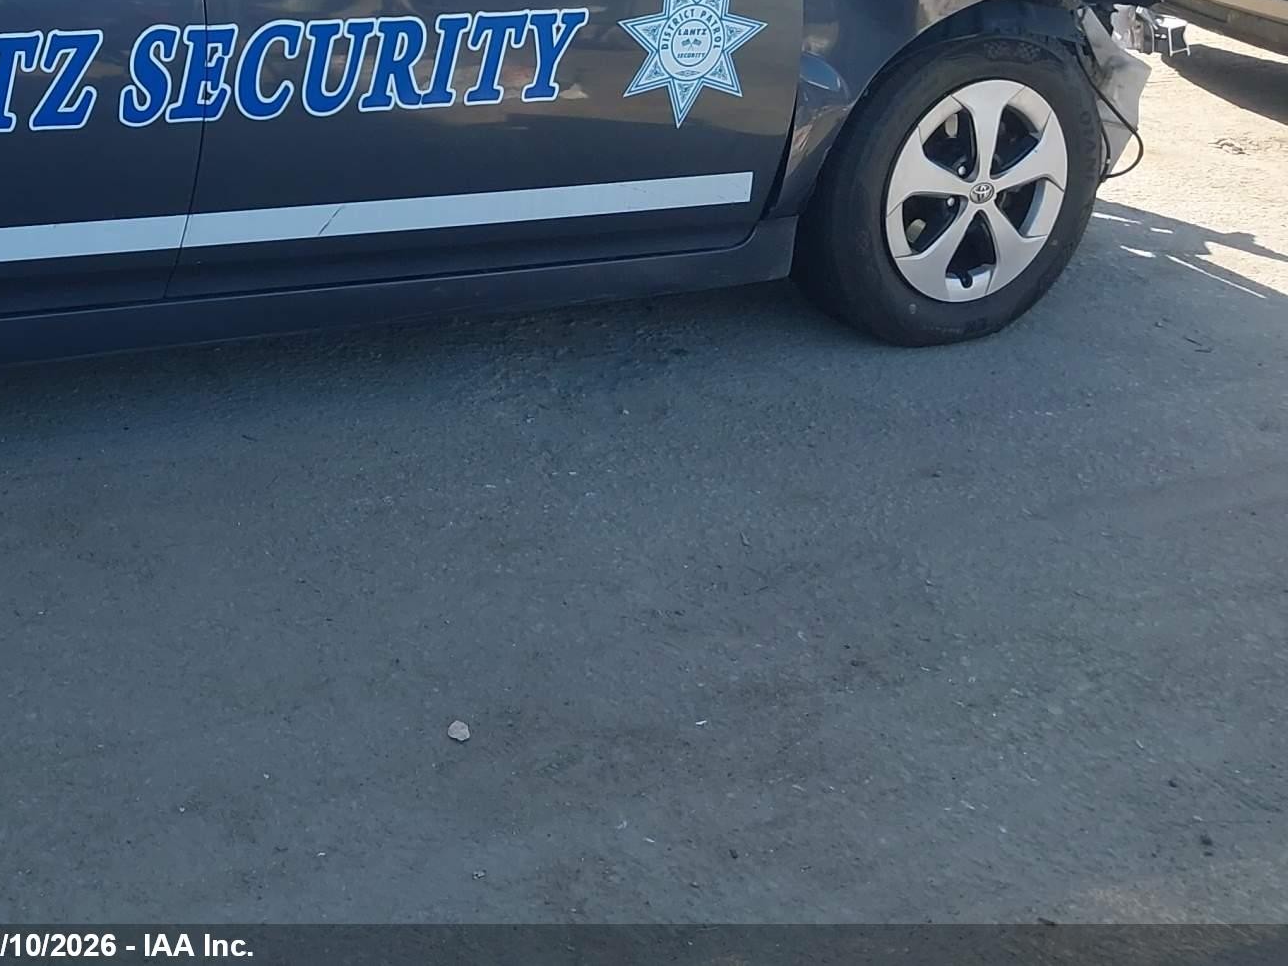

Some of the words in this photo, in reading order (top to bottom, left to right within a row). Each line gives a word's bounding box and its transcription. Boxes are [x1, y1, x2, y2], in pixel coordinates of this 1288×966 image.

[661, 9, 696, 50] DISTRICT
[699, 10, 722, 49] PATROL
[677, 28, 707, 36] LANTZ
[119, 8, 589, 127] SECURITY
